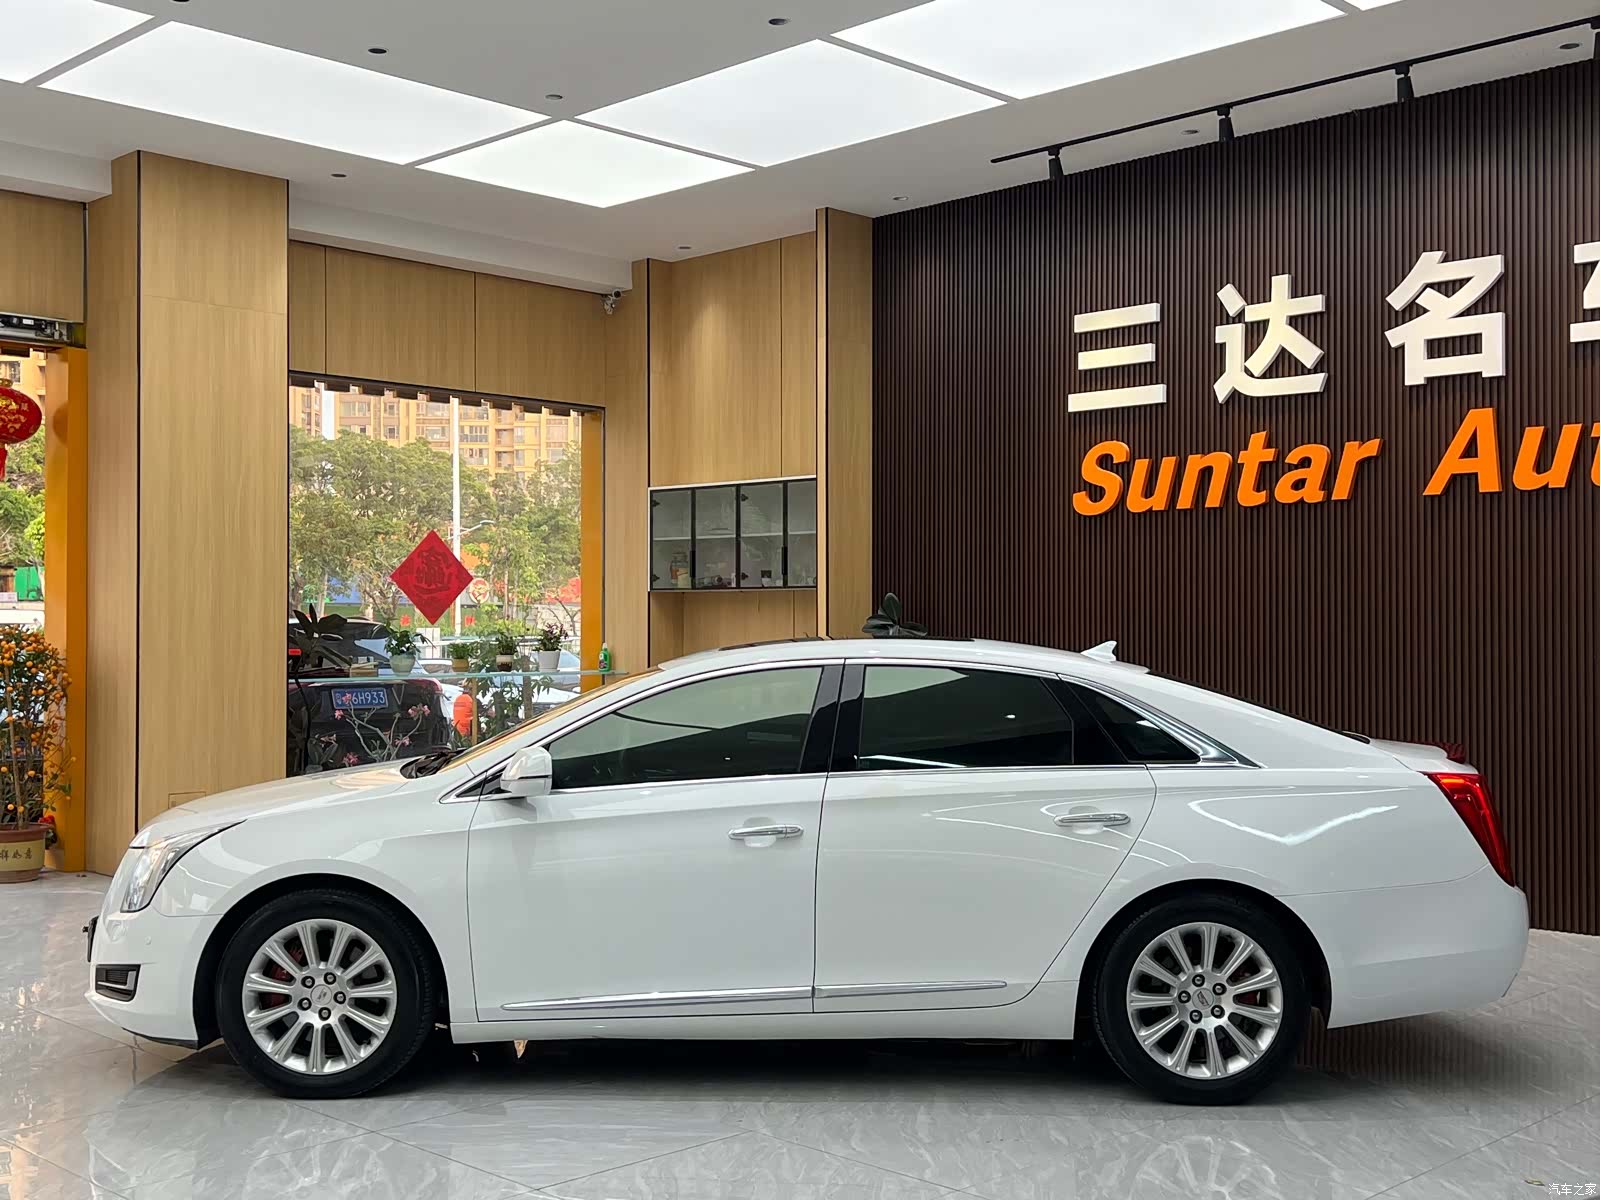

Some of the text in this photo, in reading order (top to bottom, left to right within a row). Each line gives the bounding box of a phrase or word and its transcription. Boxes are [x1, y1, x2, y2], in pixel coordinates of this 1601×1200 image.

[1068, 241, 1600, 413] 三达名
[1073, 430, 1381, 516] Suntar
